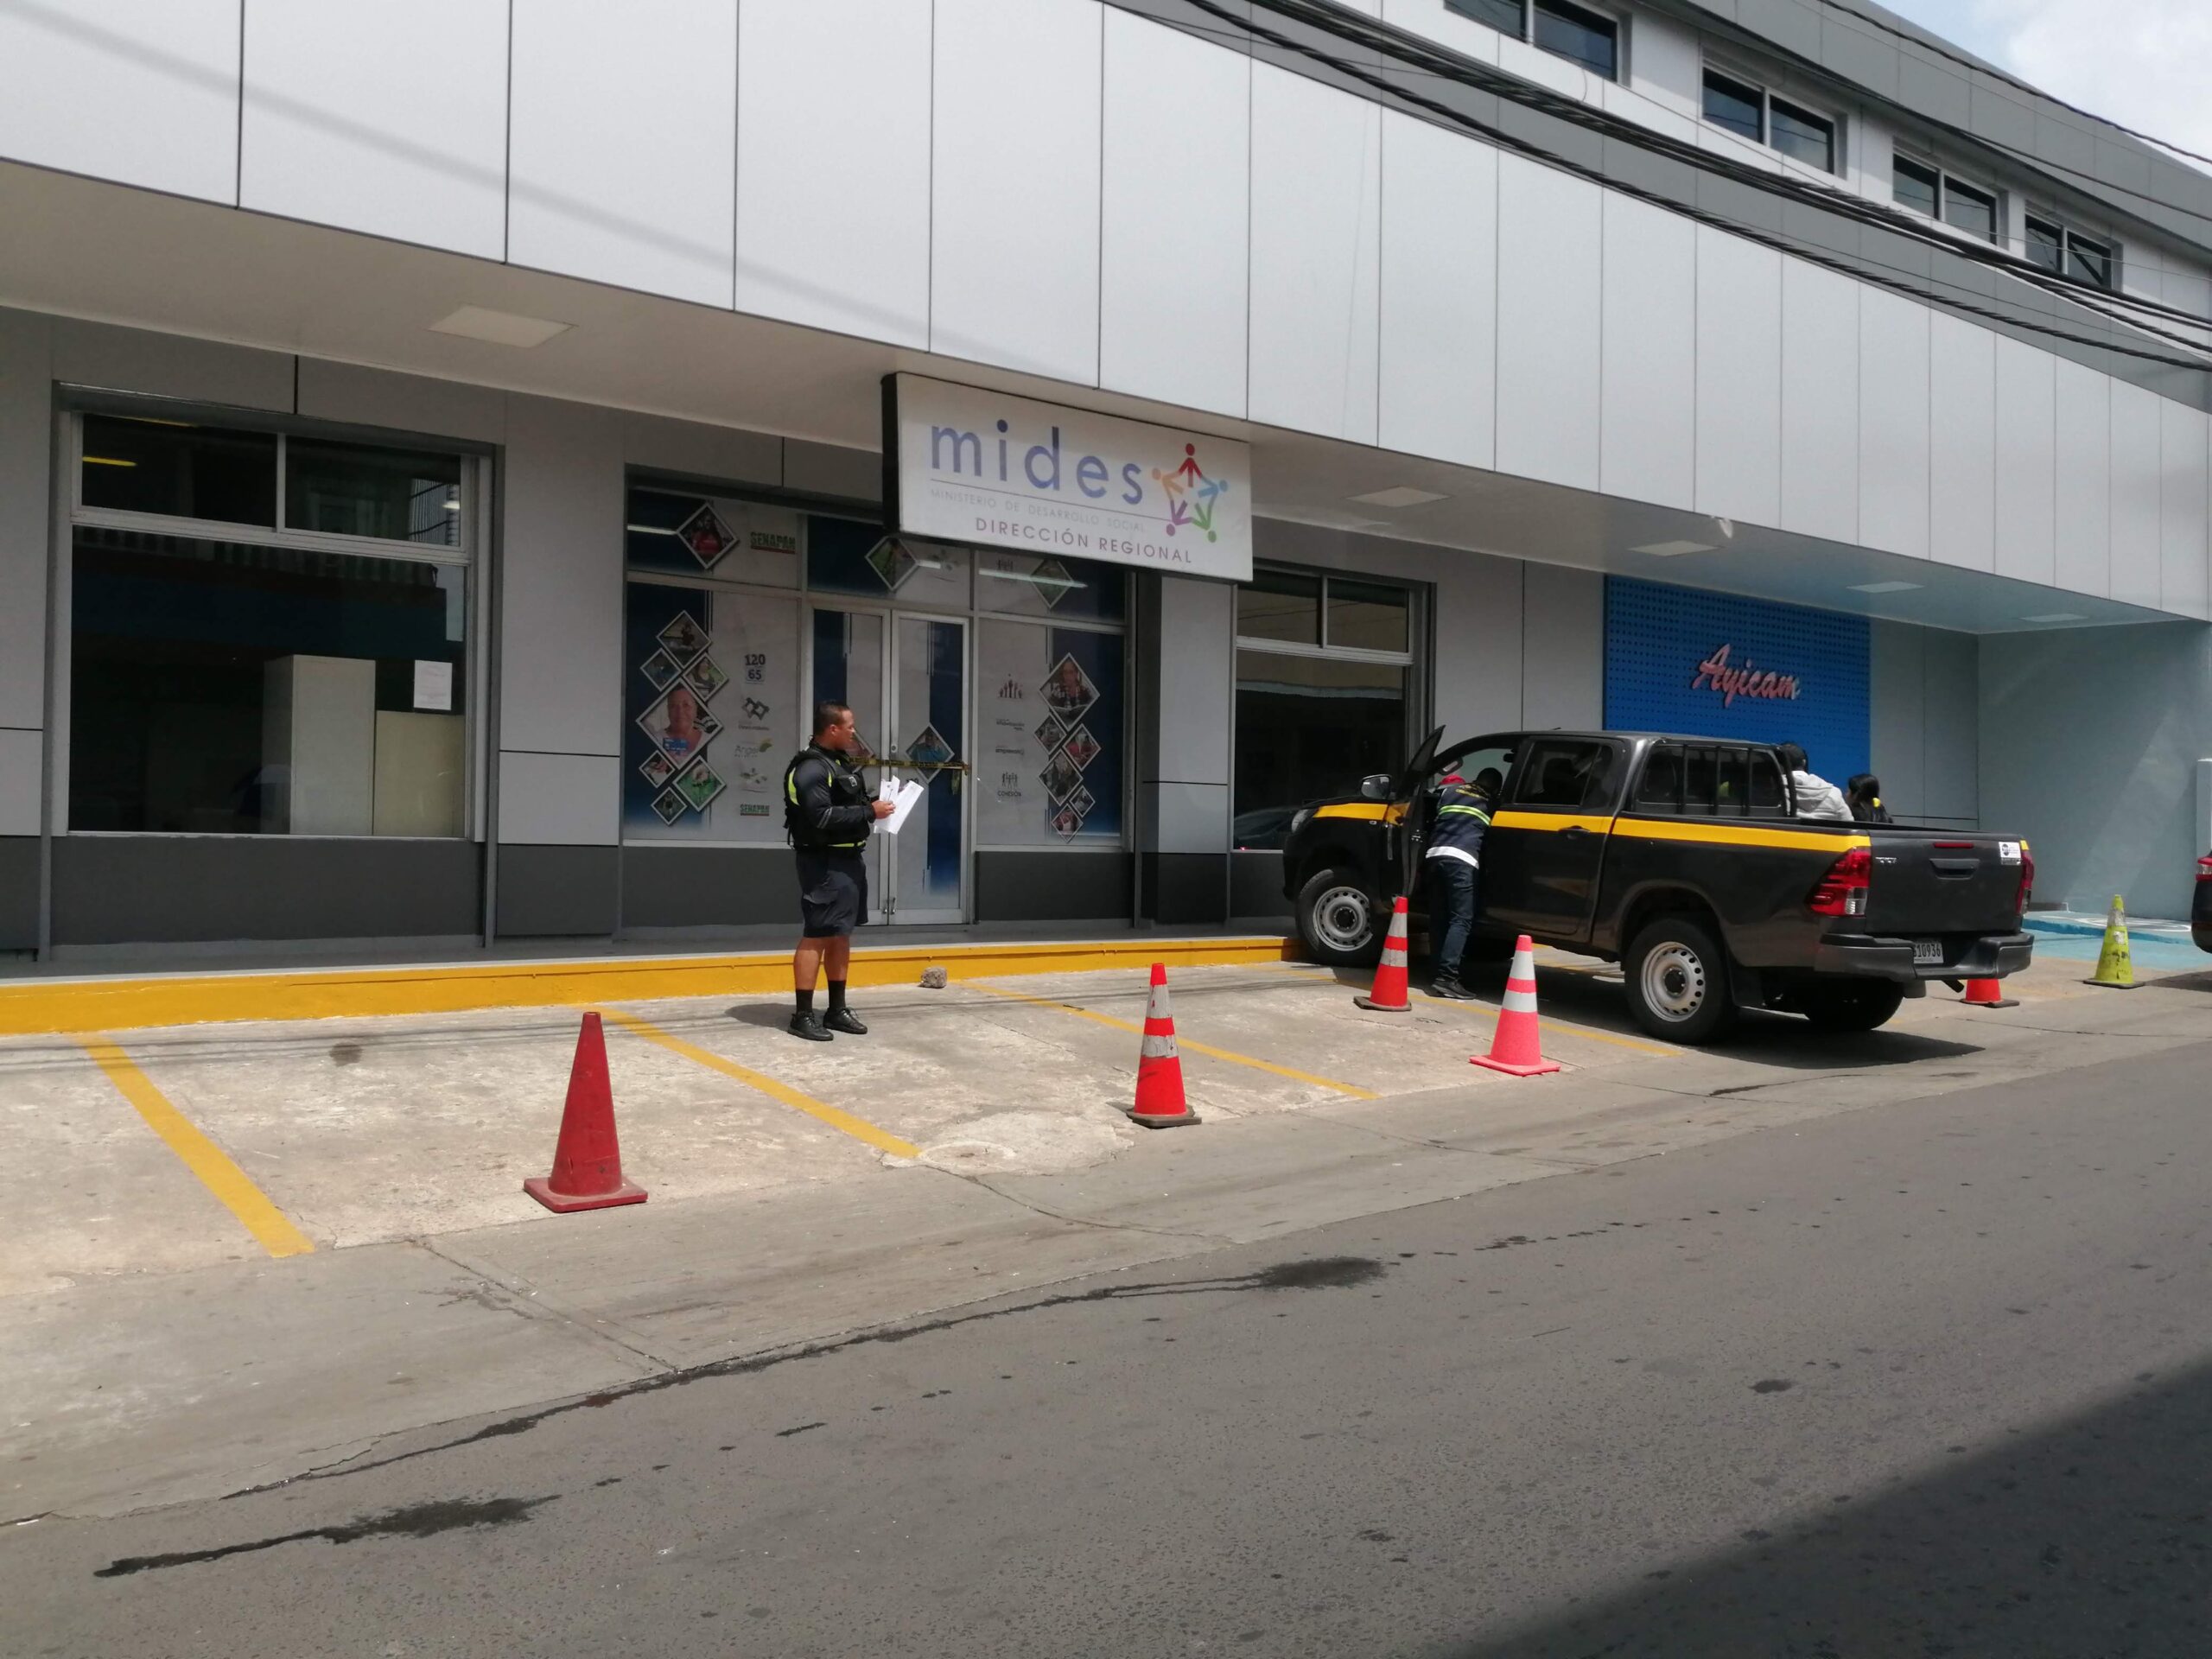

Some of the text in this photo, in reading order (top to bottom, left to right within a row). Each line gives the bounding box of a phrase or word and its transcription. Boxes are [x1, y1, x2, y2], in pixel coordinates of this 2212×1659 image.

[931, 419, 1143, 505] mides
[931, 489, 1146, 533] MINISTERIO DE DESARROLLO SOCIAL
[976, 517, 1192, 564] DIRECCIÓN REGIONAL
[745, 654, 766, 666] 120
[747, 669, 762, 681] 65
